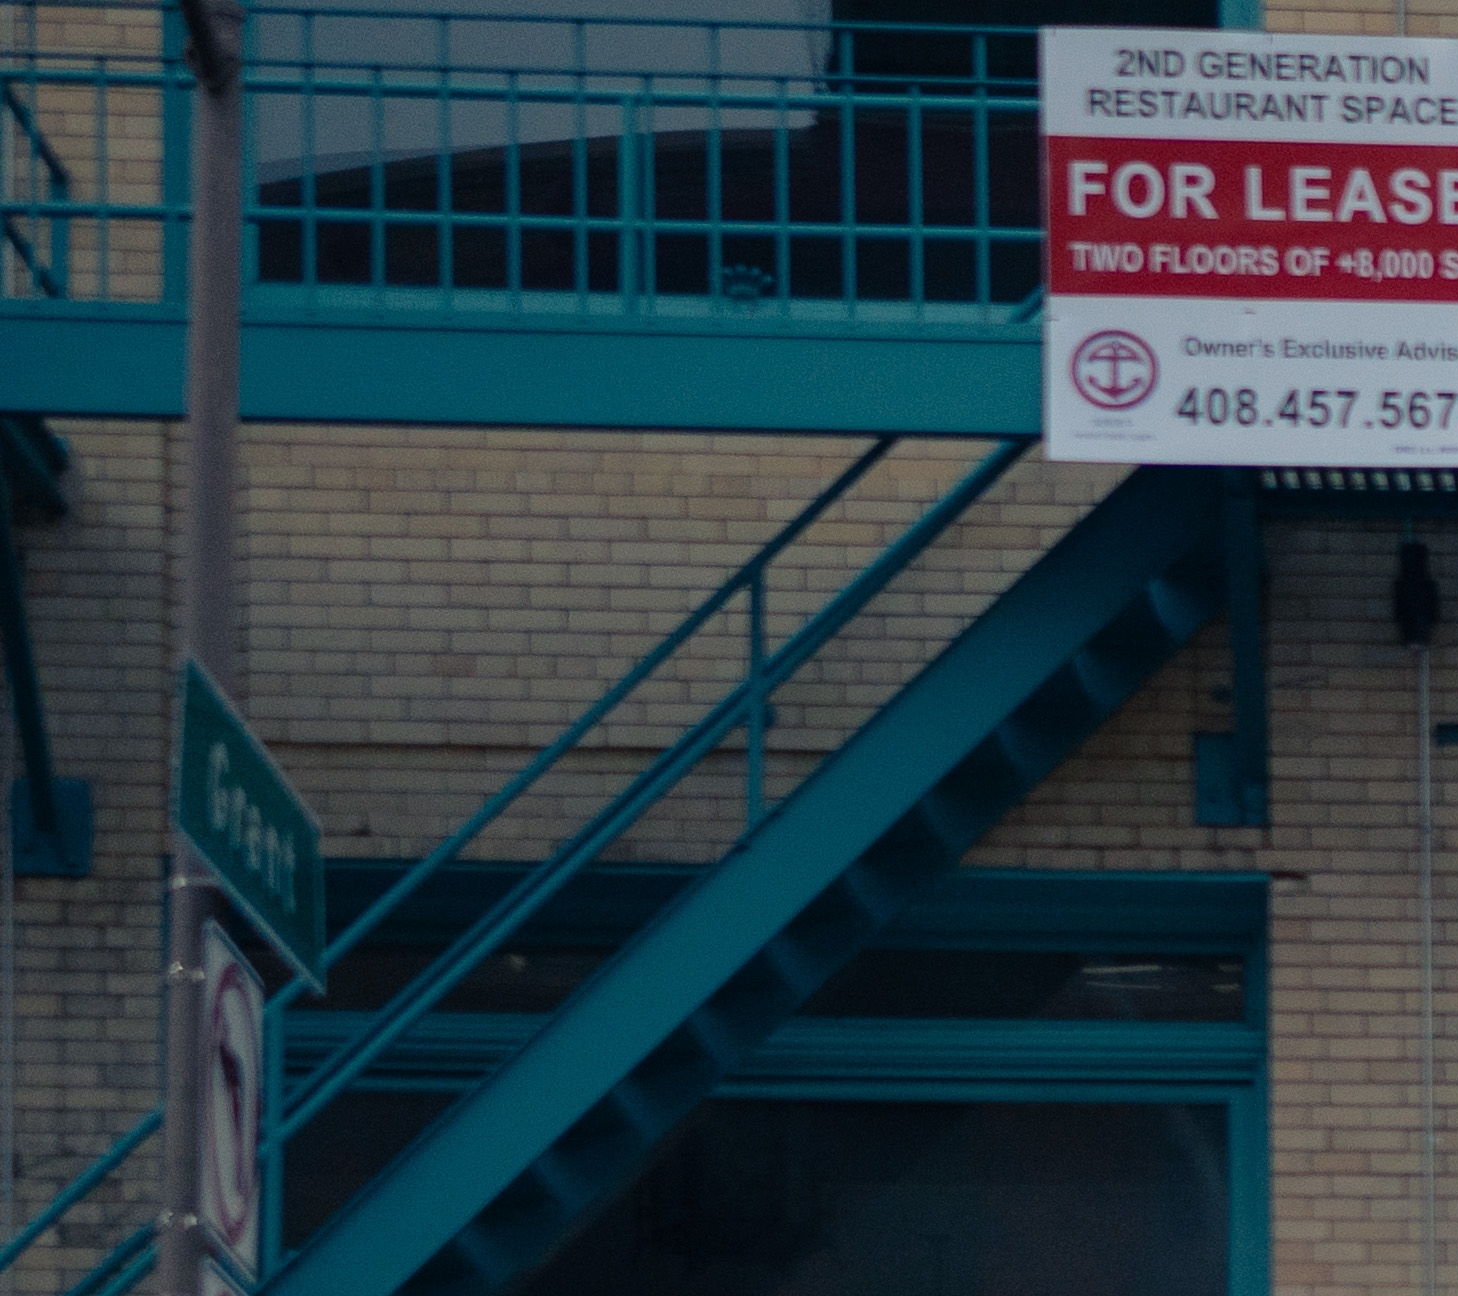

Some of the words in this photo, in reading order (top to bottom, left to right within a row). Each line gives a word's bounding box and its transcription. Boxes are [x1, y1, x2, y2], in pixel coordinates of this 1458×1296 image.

[1114, 49, 1184, 79] 2ND
[1199, 50, 1430, 86] GENERATION
[1087, 89, 1328, 122] RESTAURANT
[1067, 160, 1219, 219] FOR
[1068, 241, 1143, 273] TWO
[1149, 244, 1279, 276] FLOORS
[1285, 247, 1329, 276] OF
[1184, 337, 1275, 361] Owner's
[1283, 339, 1389, 362] Exclusive
